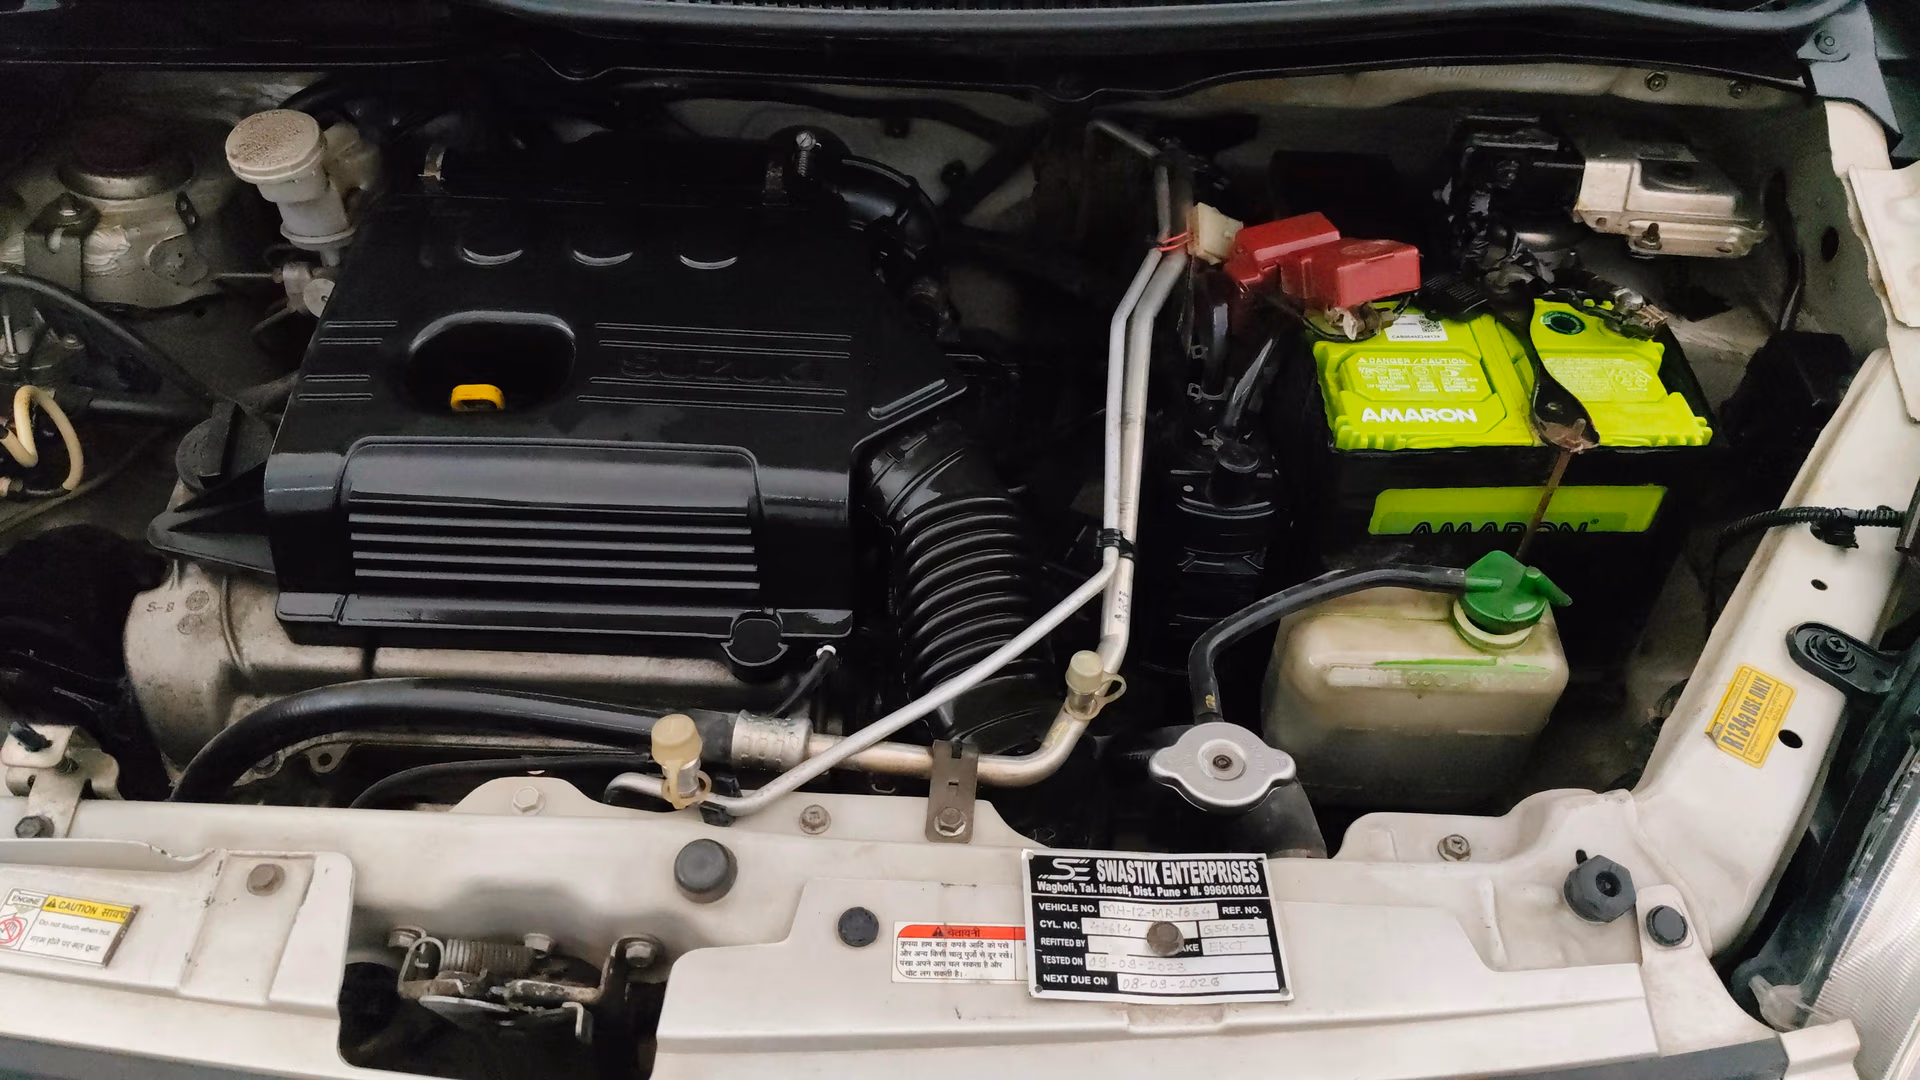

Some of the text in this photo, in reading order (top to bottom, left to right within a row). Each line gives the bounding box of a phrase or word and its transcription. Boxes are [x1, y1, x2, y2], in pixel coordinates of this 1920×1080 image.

[1362, 408, 1478, 422] AMARON
[1721, 676, 1772, 751] R134a USE ONLY
[1096, 859, 1160, 884] SWASTIK
[1162, 860, 1259, 885] ENTERPRISES
[1037, 881, 1262, 897] Wagholi, Tal. Haveli, Dist. Pune M. 9960108184
[12, 895, 40, 904] ENGINE
[58, 901, 98, 915] CAUTION
[1039, 903, 1098, 913] VEHICLE NO.
[1245, 906, 1262, 914] NO.
[1040, 920, 1080, 929] CYL. NO.
[947, 927, 980, 937] चेतावनी
[987, 941, 995, 949] को
[1041, 937, 1074, 946] REFITTED
[1181, 944, 1199, 952] AKE
[900, 949, 912, 957] और
[979, 950, 985, 958] से
[988, 951, 996, 960] दूर
[915, 959, 931, 967] अपने
[983, 959, 989, 968] है
[991, 960, 1002, 968] और
[1042, 955, 1083, 965] TESTED ON
[1043, 974, 1108, 985] NEXT DUE ON
